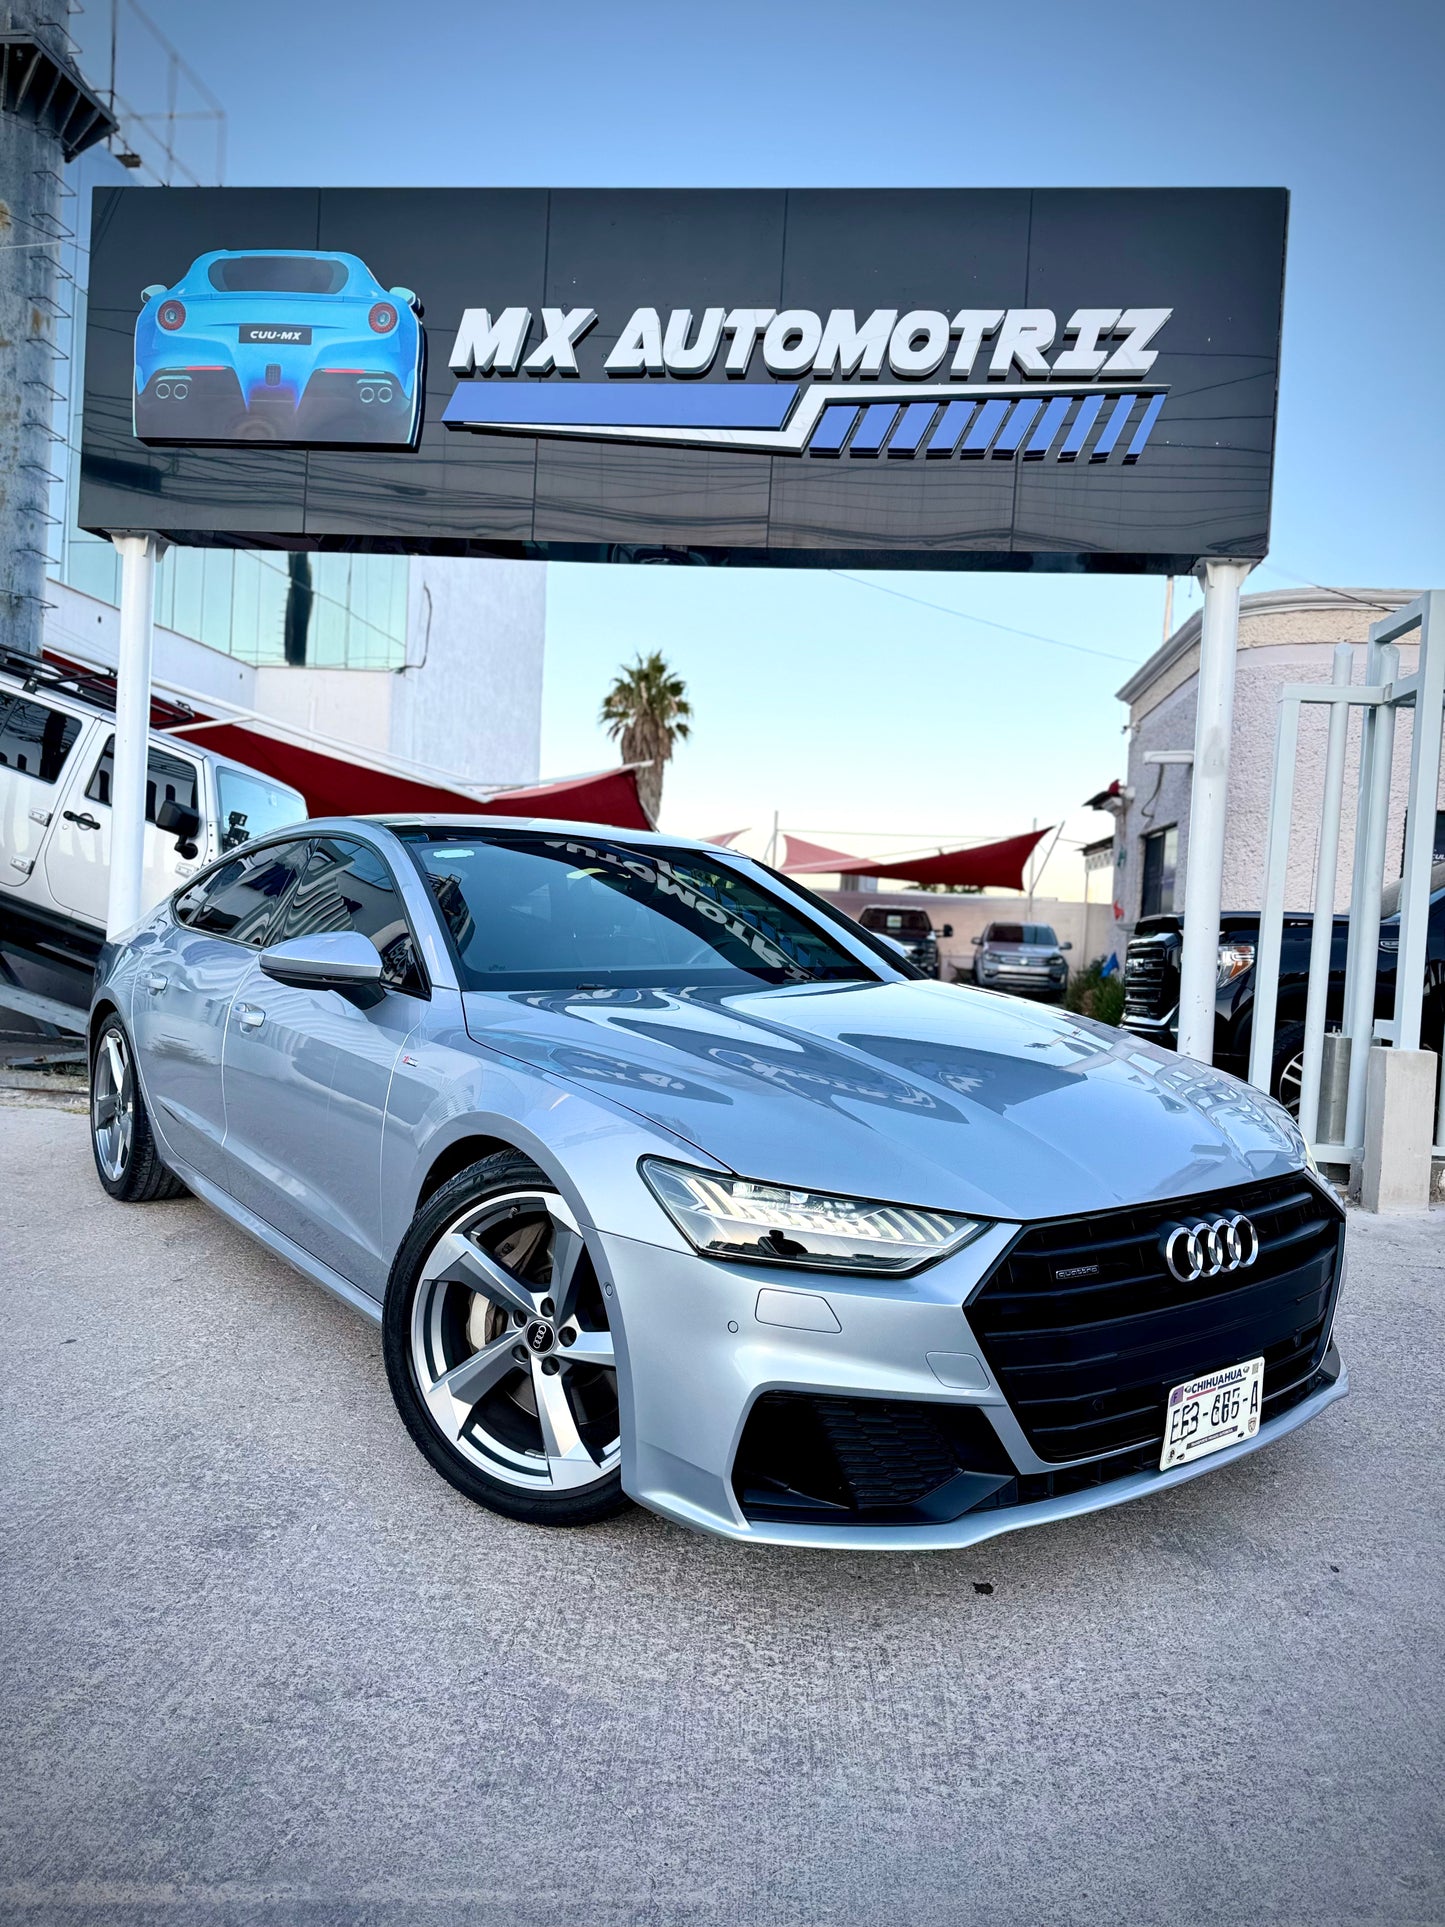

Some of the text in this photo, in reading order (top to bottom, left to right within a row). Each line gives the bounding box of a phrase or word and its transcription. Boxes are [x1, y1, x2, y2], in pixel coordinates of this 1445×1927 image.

[250, 330, 302, 341] CUU-MX
[448, 306, 1174, 378] MX AUTOMOTRIZ
[1191, 1368, 1243, 1394] CHIHUAHUA
